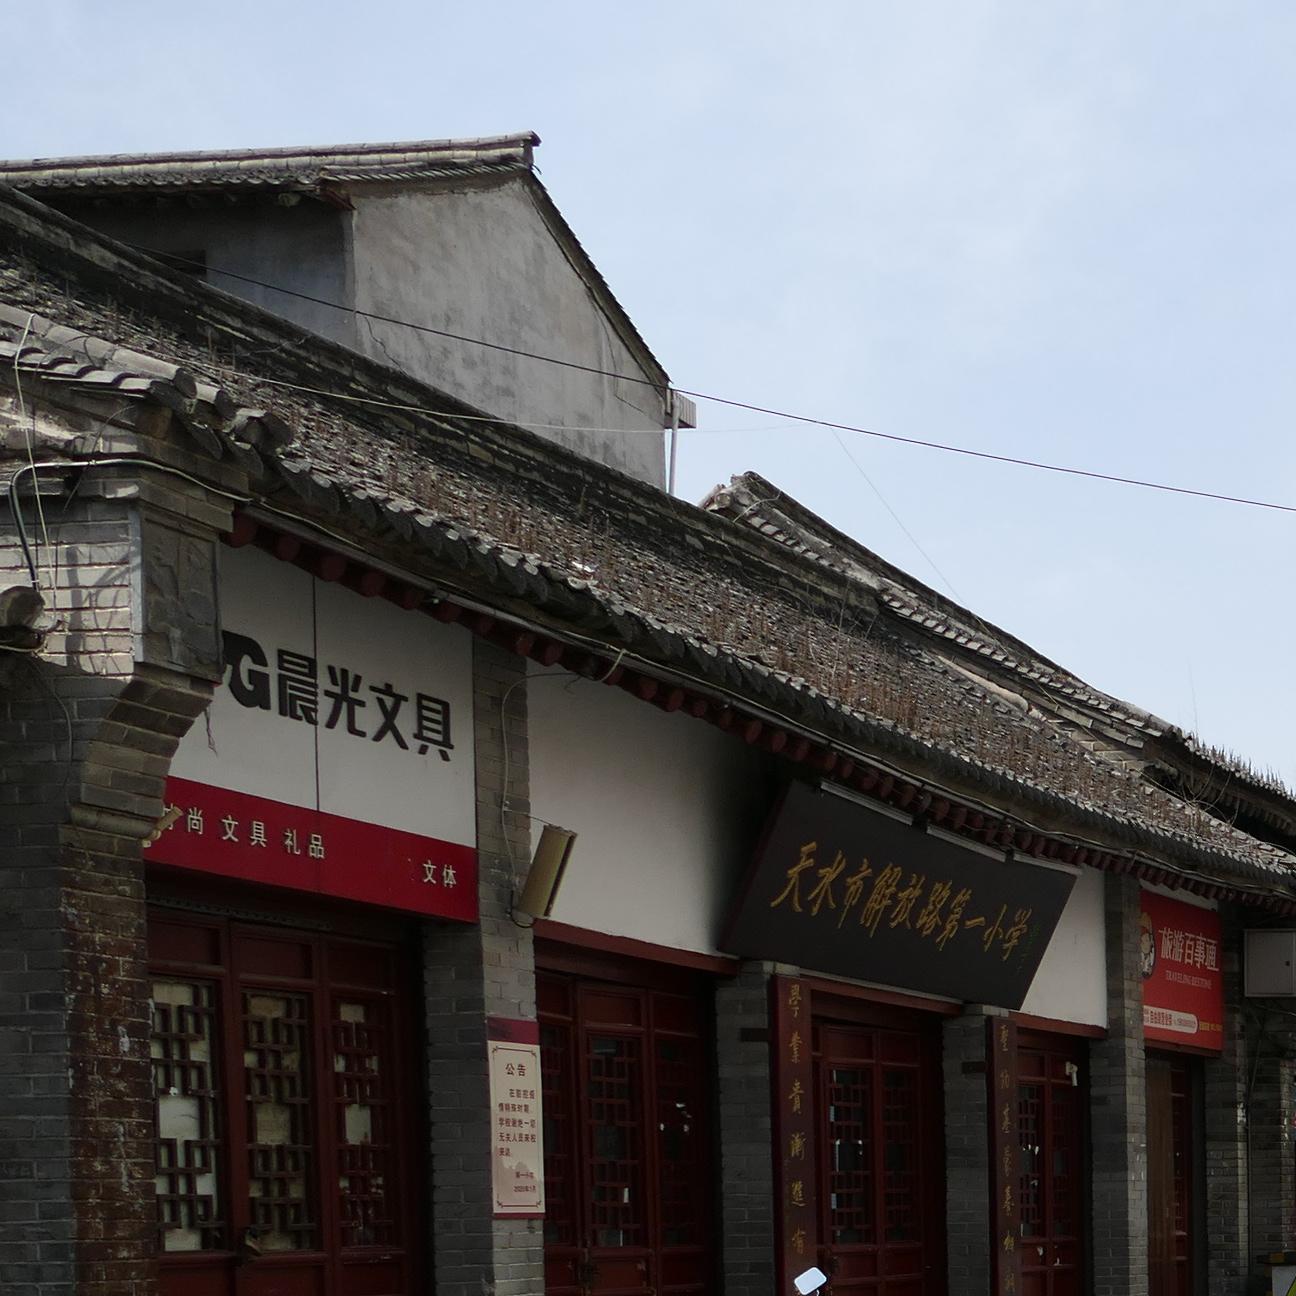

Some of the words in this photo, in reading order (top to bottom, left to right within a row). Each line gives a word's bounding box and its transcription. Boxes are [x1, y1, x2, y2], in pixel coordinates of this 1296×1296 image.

[276, 648, 455, 763] 晨光文具
[221, 815, 268, 849] 文具
[284, 828, 325, 860] 礼品
[422, 860, 457, 889] 文体
[769, 840, 1033, 963] 天水市解放路第一小学
[1158, 927, 1219, 971] 旅游百事通
[505, 1063, 526, 1077] 公告
